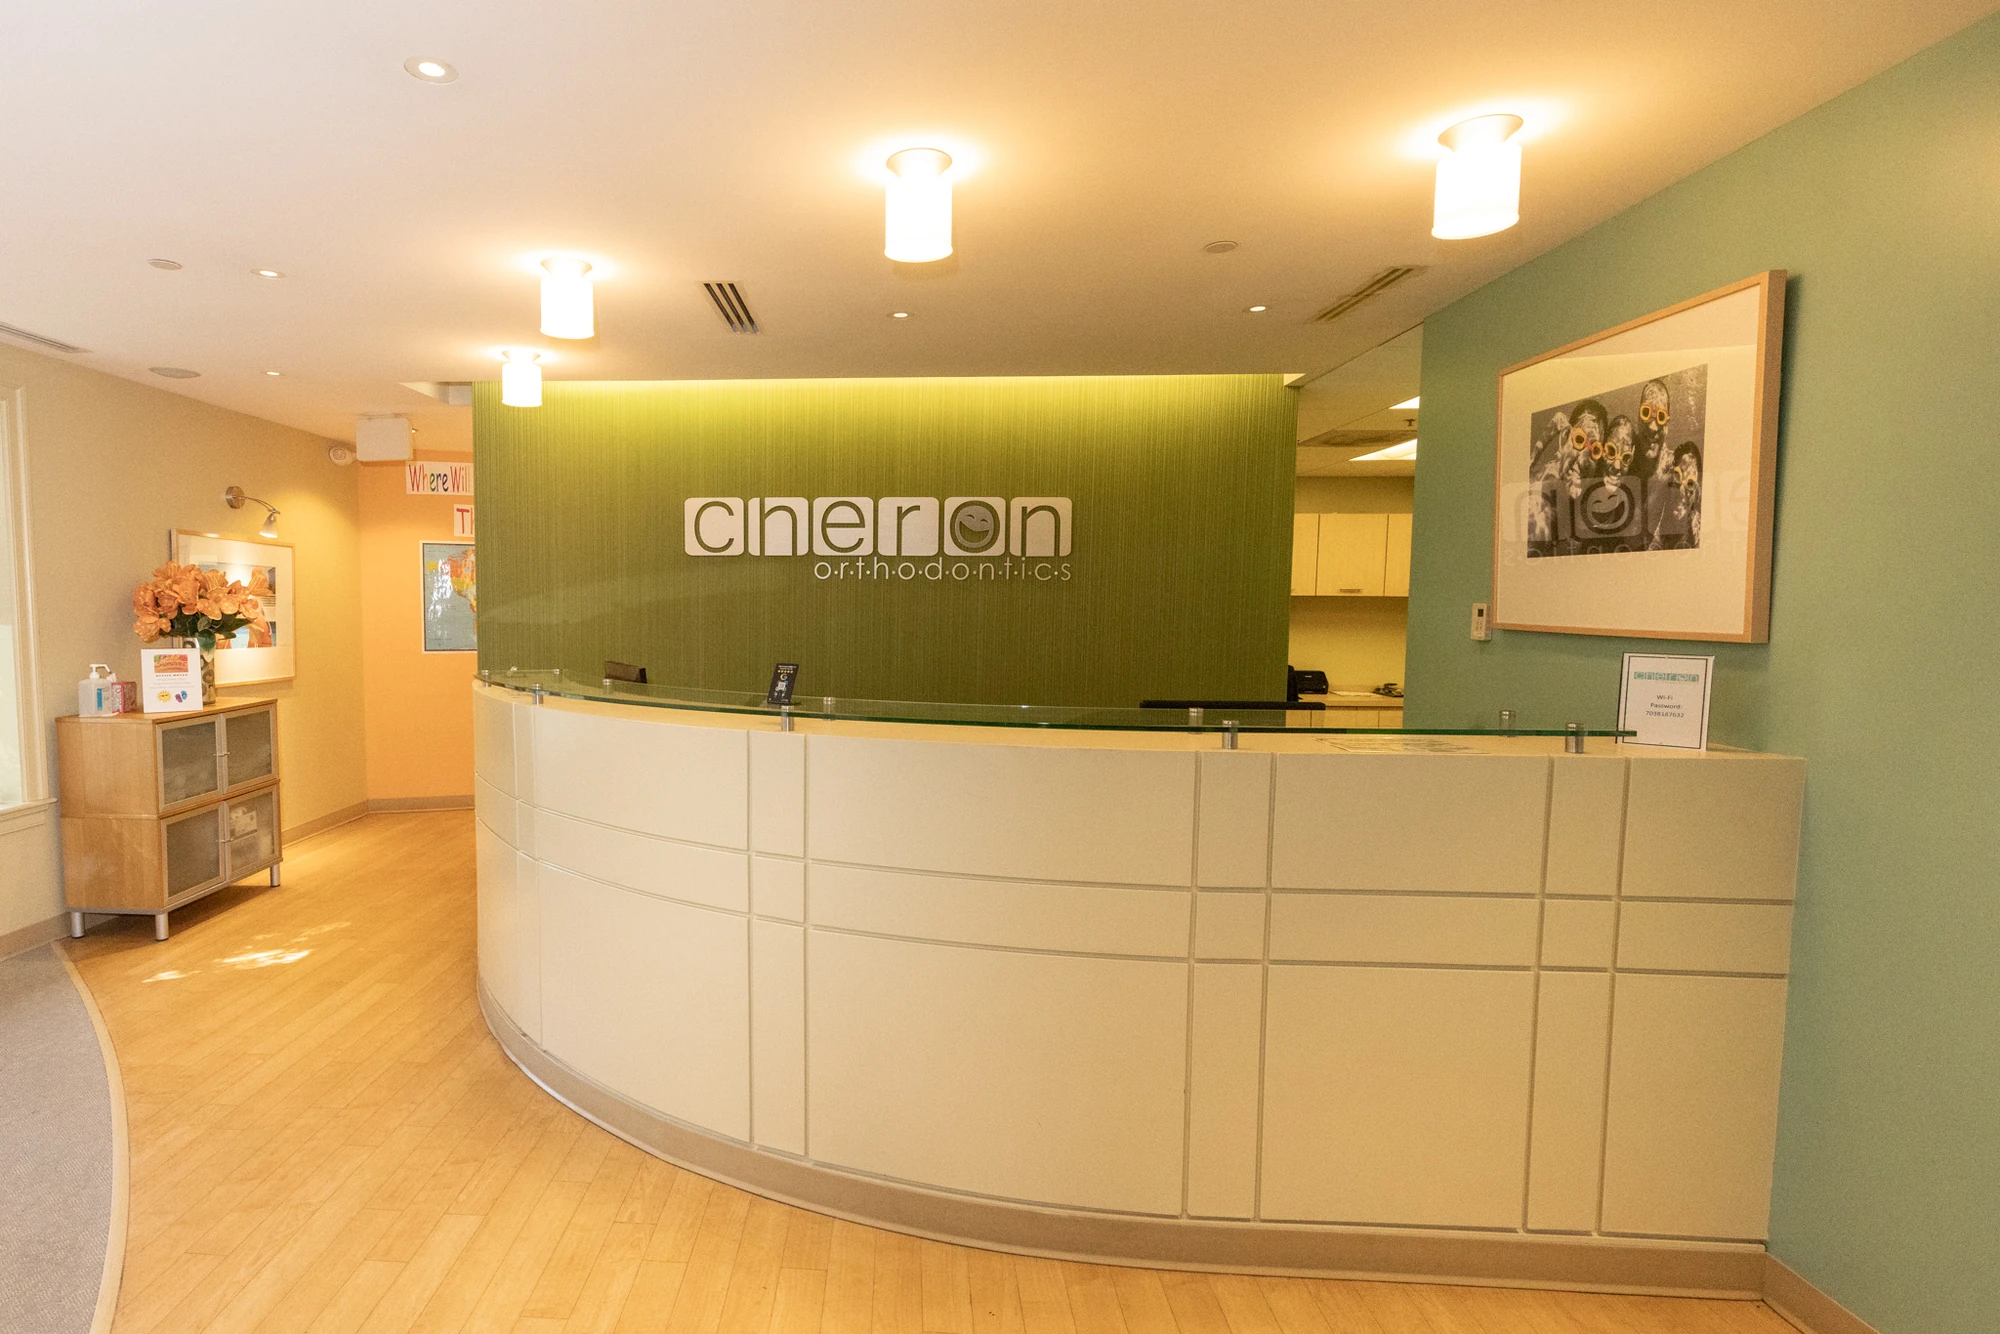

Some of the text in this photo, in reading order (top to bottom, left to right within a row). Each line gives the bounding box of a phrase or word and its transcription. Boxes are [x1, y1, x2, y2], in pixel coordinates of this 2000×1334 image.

[408, 463, 449, 492] Where
[688, 498, 1068, 556] cheron
[1650, 702, 1683, 710] Password:
